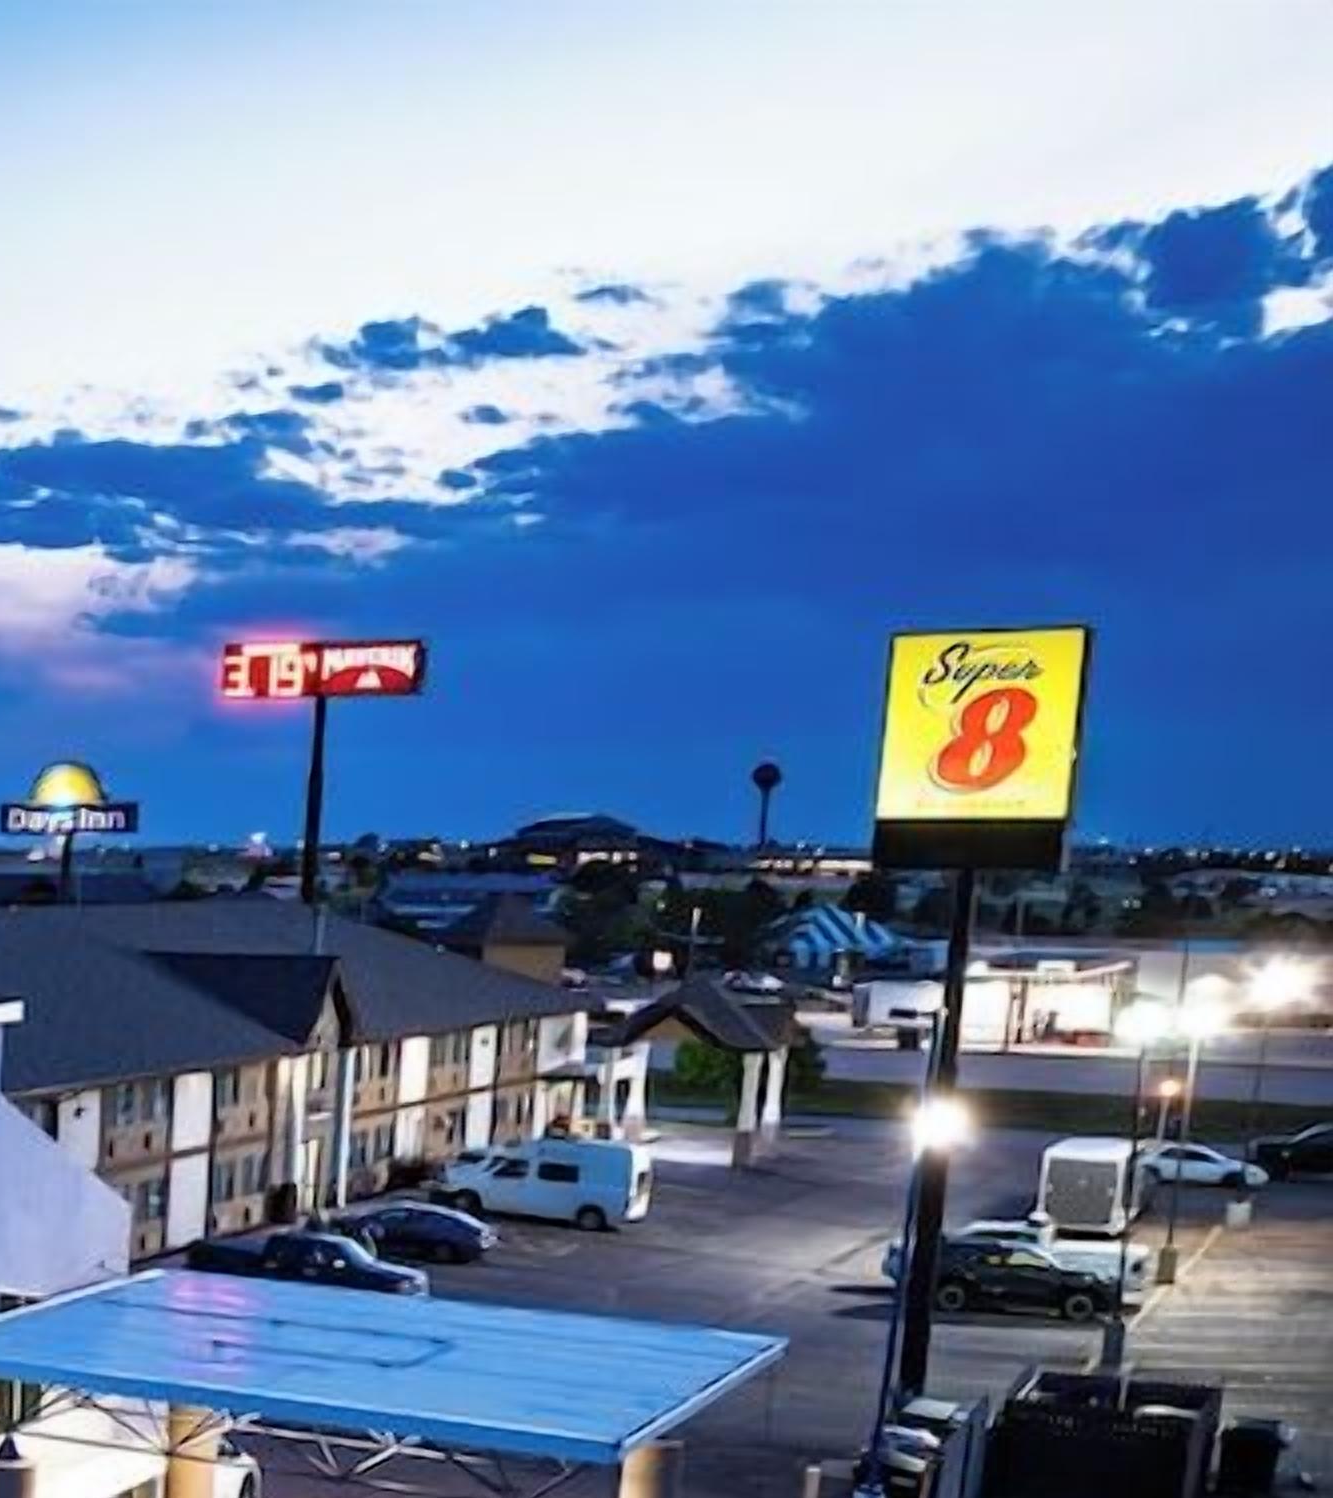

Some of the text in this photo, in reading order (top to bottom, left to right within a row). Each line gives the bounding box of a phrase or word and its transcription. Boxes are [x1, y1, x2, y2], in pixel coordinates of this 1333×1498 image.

[921, 641, 1045, 704] Super
[936, 686, 1038, 788] 8
[79, 806, 126, 831] Inn
